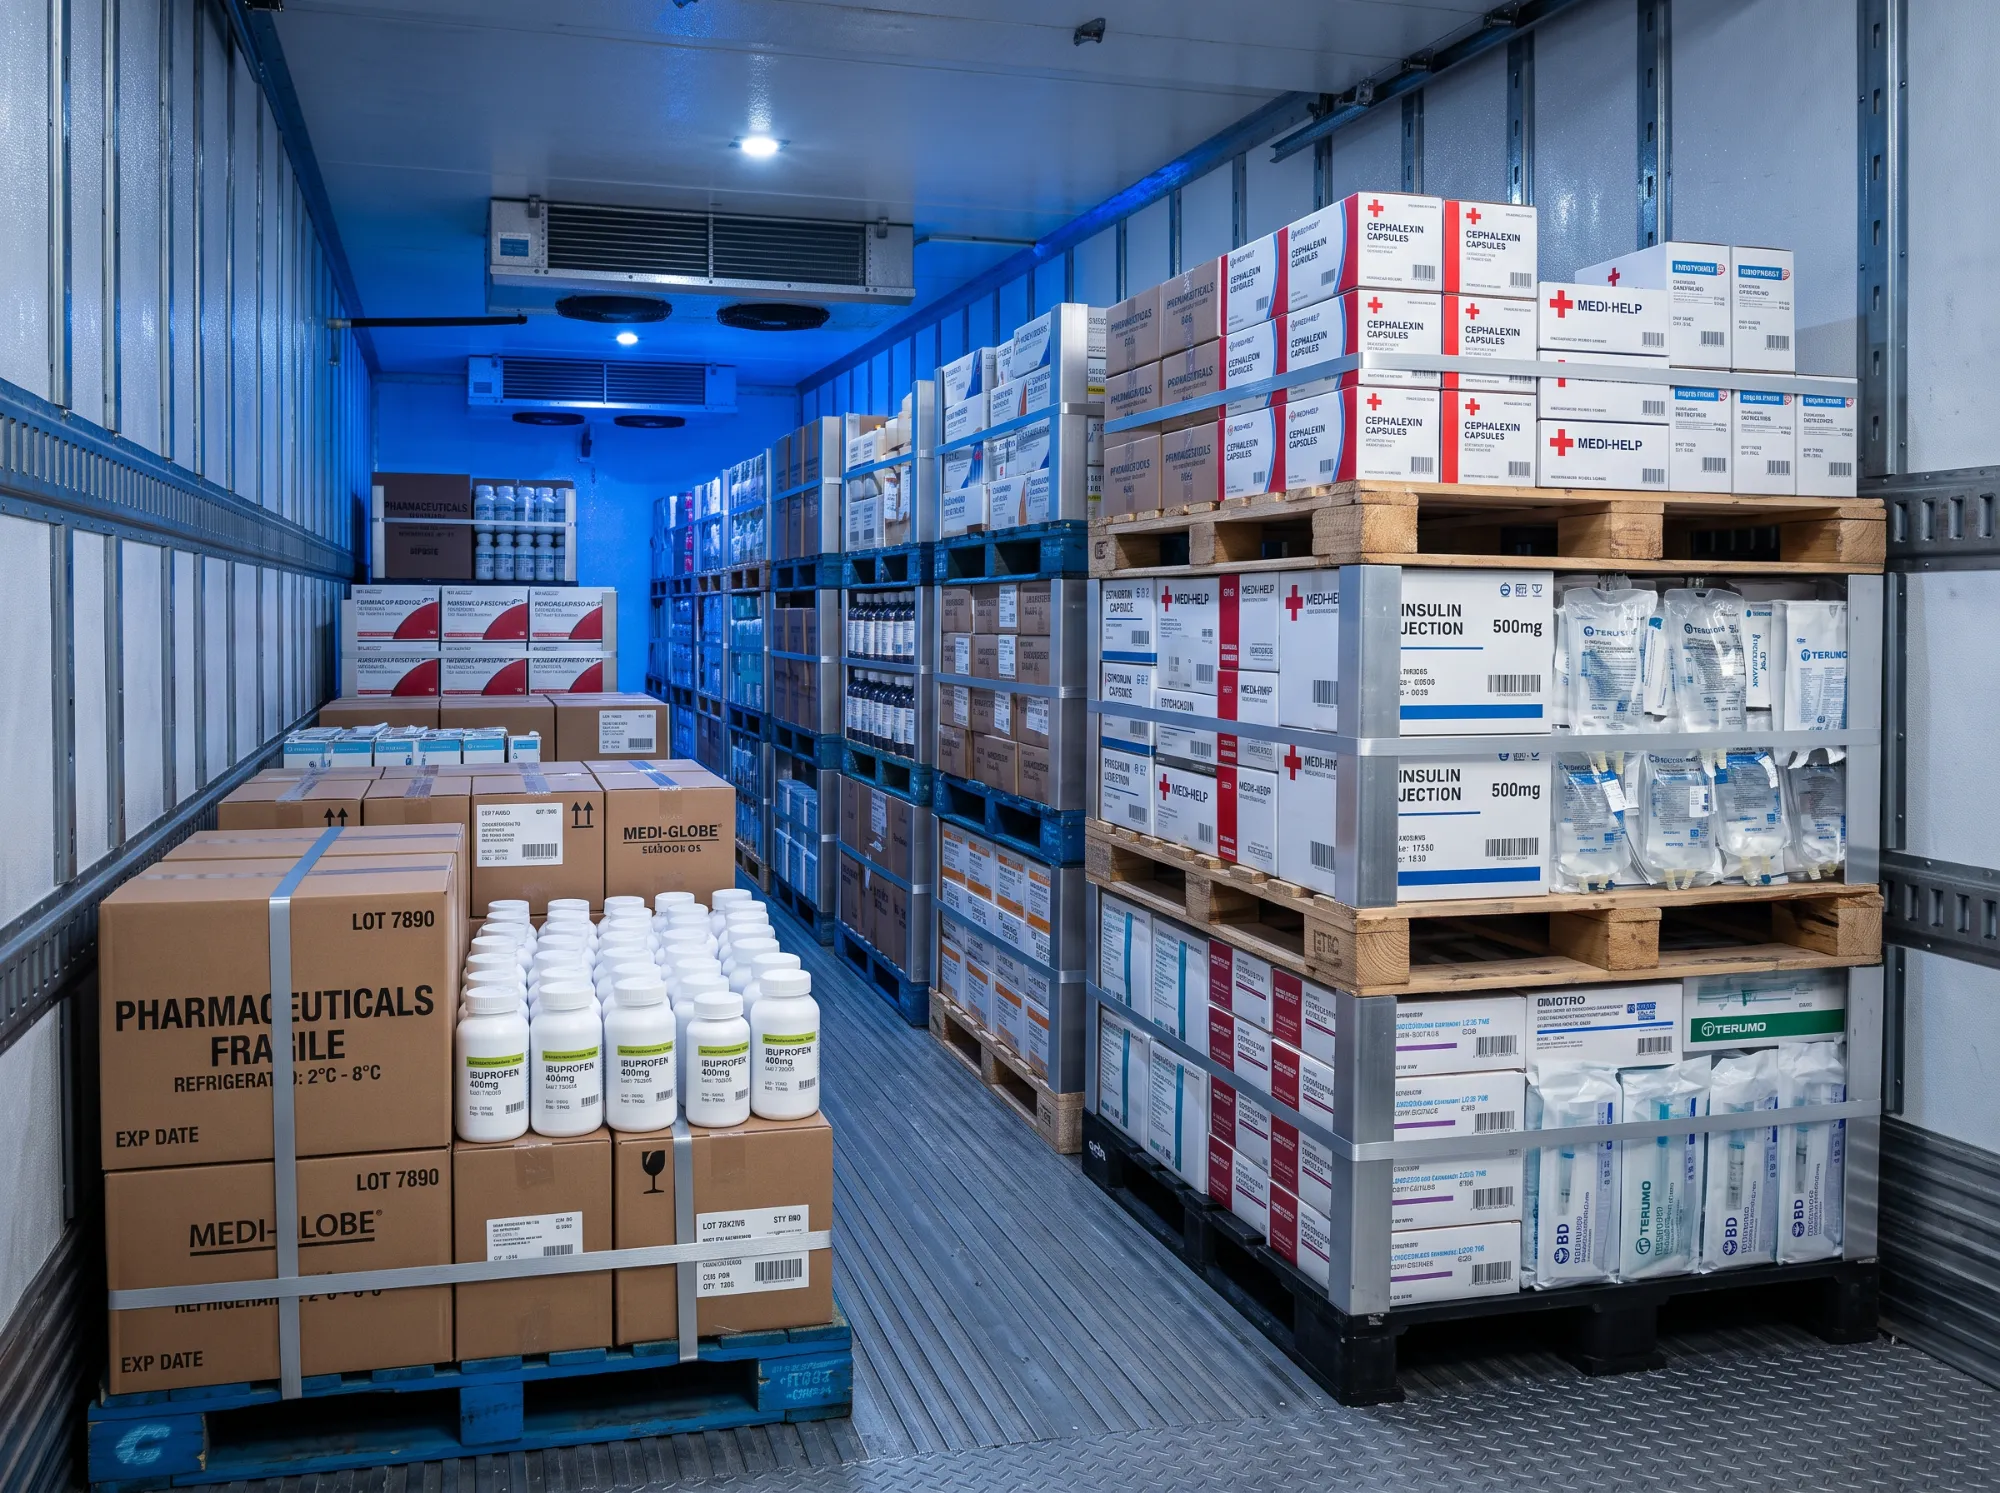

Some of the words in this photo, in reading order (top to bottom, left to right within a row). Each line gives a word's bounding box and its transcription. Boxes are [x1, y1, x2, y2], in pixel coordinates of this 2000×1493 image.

[1367, 223, 1424, 233] CEPHALEXIN
[1367, 233, 1408, 242] CAPSULES
[1466, 230, 1520, 242] CEPHALEXIN
[1466, 241, 1506, 250] CAPSULES
[1578, 299, 1642, 315] MEDI-HELP
[1367, 320, 1424, 330] CEPHALEXIN
[1367, 331, 1408, 339] CAPSULES
[1465, 326, 1520, 337] CEPHALEXIN
[1465, 336, 1505, 345] CAPSULES
[1366, 417, 1423, 426] CEPHALEXIN
[1465, 421, 1520, 431] CEPHALEXIN
[1366, 427, 1407, 435] CAPSULES
[1465, 431, 1504, 440] CAPSULES
[1578, 438, 1642, 451] MEDI-HELP
[1401, 604, 1462, 617] INSULIN
[1493, 619, 1542, 637] 500mg
[1399, 769, 1460, 783] INSULIN
[1492, 783, 1540, 800] 500mg
[352, 912, 386, 931] LOT
[391, 910, 435, 929] 7890
[1715, 1022, 1766, 1034] TERUMO
[211, 1029, 346, 1067] FRAILE
[621, 1057, 668, 1067] IBUPROFEN
[765, 1057, 792, 1066] 400mg
[546, 1062, 594, 1073] IBUPROFEN
[308, 1067, 337, 1085] 2°C
[352, 1065, 381, 1082] 8°C
[470, 1068, 519, 1079] IBUPROFEN
[546, 1075, 575, 1083] 400mg
[621, 1069, 649, 1078] 400mg
[702, 1069, 730, 1078] 400mg
[470, 1080, 498, 1090] 400mg
[116, 1131, 149, 1148] EXP
[156, 1127, 199, 1145] DATE
[357, 1172, 390, 1191] LOT
[397, 1168, 439, 1188] 7890
[1640, 1180, 1652, 1236] TERUMO
[1794, 1200, 1804, 1219] BD
[703, 1222, 716, 1230] LOT
[1725, 1217, 1737, 1237] BD
[1557, 1224, 1569, 1244] BD
[122, 1356, 154, 1373] EXP
[160, 1351, 203, 1370] DATE
